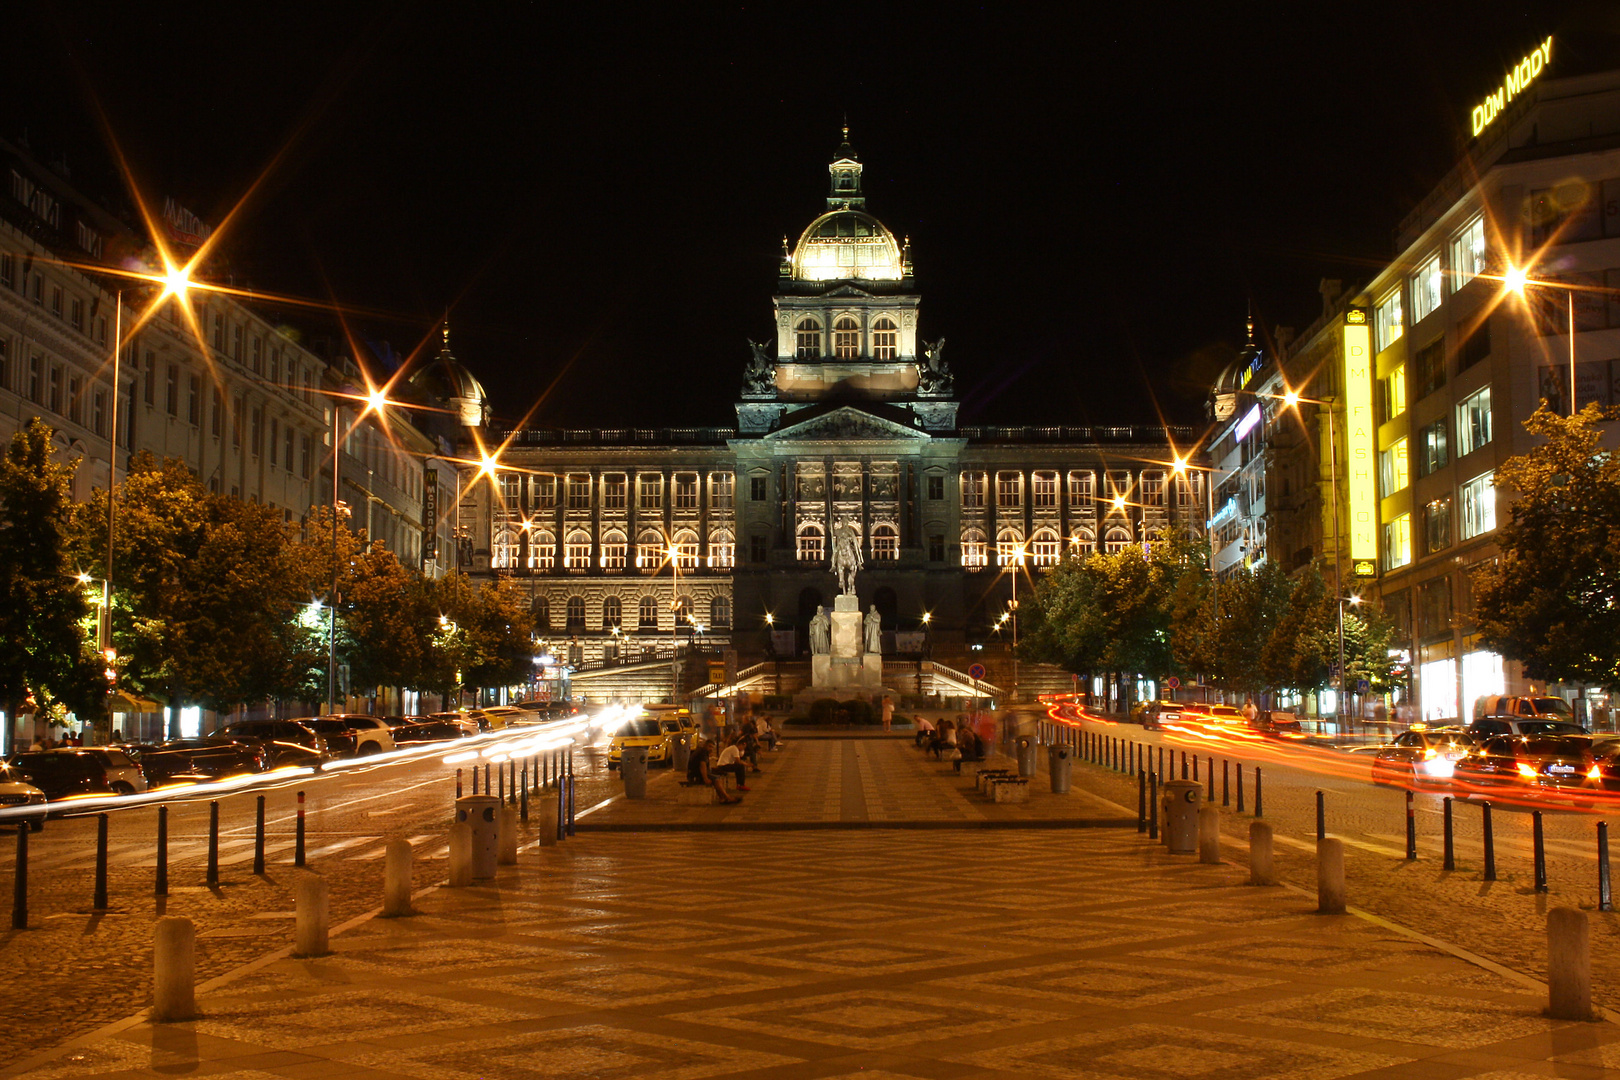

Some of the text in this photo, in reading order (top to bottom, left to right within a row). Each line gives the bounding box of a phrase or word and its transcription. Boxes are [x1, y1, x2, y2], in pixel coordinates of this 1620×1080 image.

[1472, 35, 1552, 137] DŮM MÓDY
[1351, 346, 1369, 543] DM FASHION
